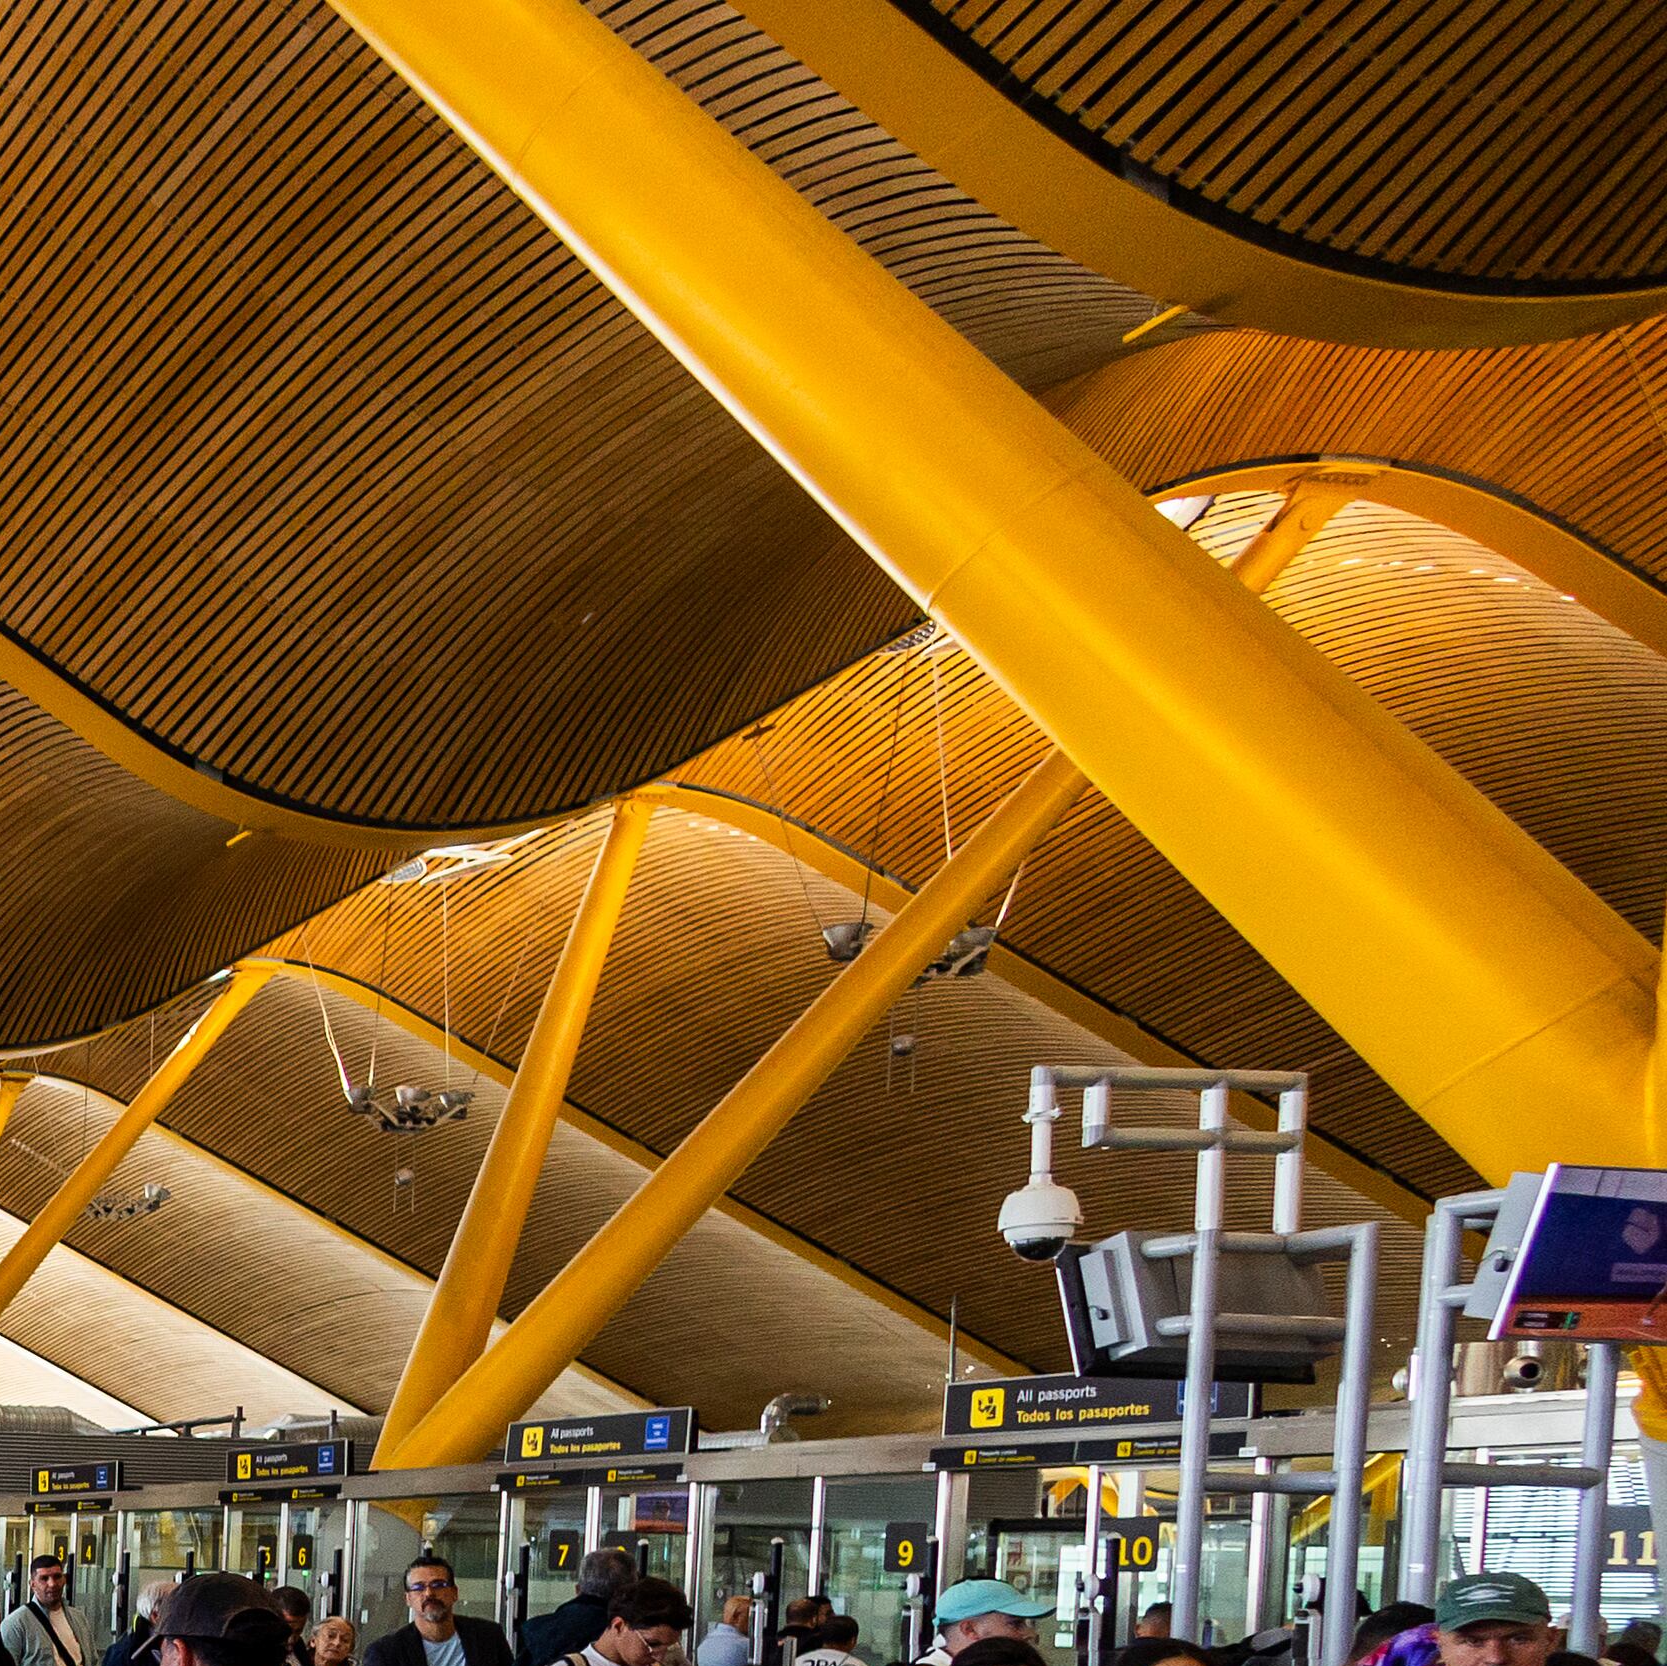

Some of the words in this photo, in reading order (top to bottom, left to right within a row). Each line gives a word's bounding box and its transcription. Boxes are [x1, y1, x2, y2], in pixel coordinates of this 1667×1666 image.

[1017, 1389, 1034, 1404] All
[1038, 1385, 1097, 1404] passports
[1016, 1409, 1051, 1424] Todos
[1055, 1408, 1074, 1421] los
[1078, 1403, 1150, 1422] pasaportes
[560, 1425, 594, 1440] passports
[58, 1545, 64, 1559] 3
[85, 1544, 92, 1558] 4
[298, 1546, 306, 1566] 6
[558, 1544, 570, 1567] 7
[897, 1539, 914, 1567] 9
[1118, 1536, 1154, 1567] 10
[1606, 1530, 1658, 1566] 11
